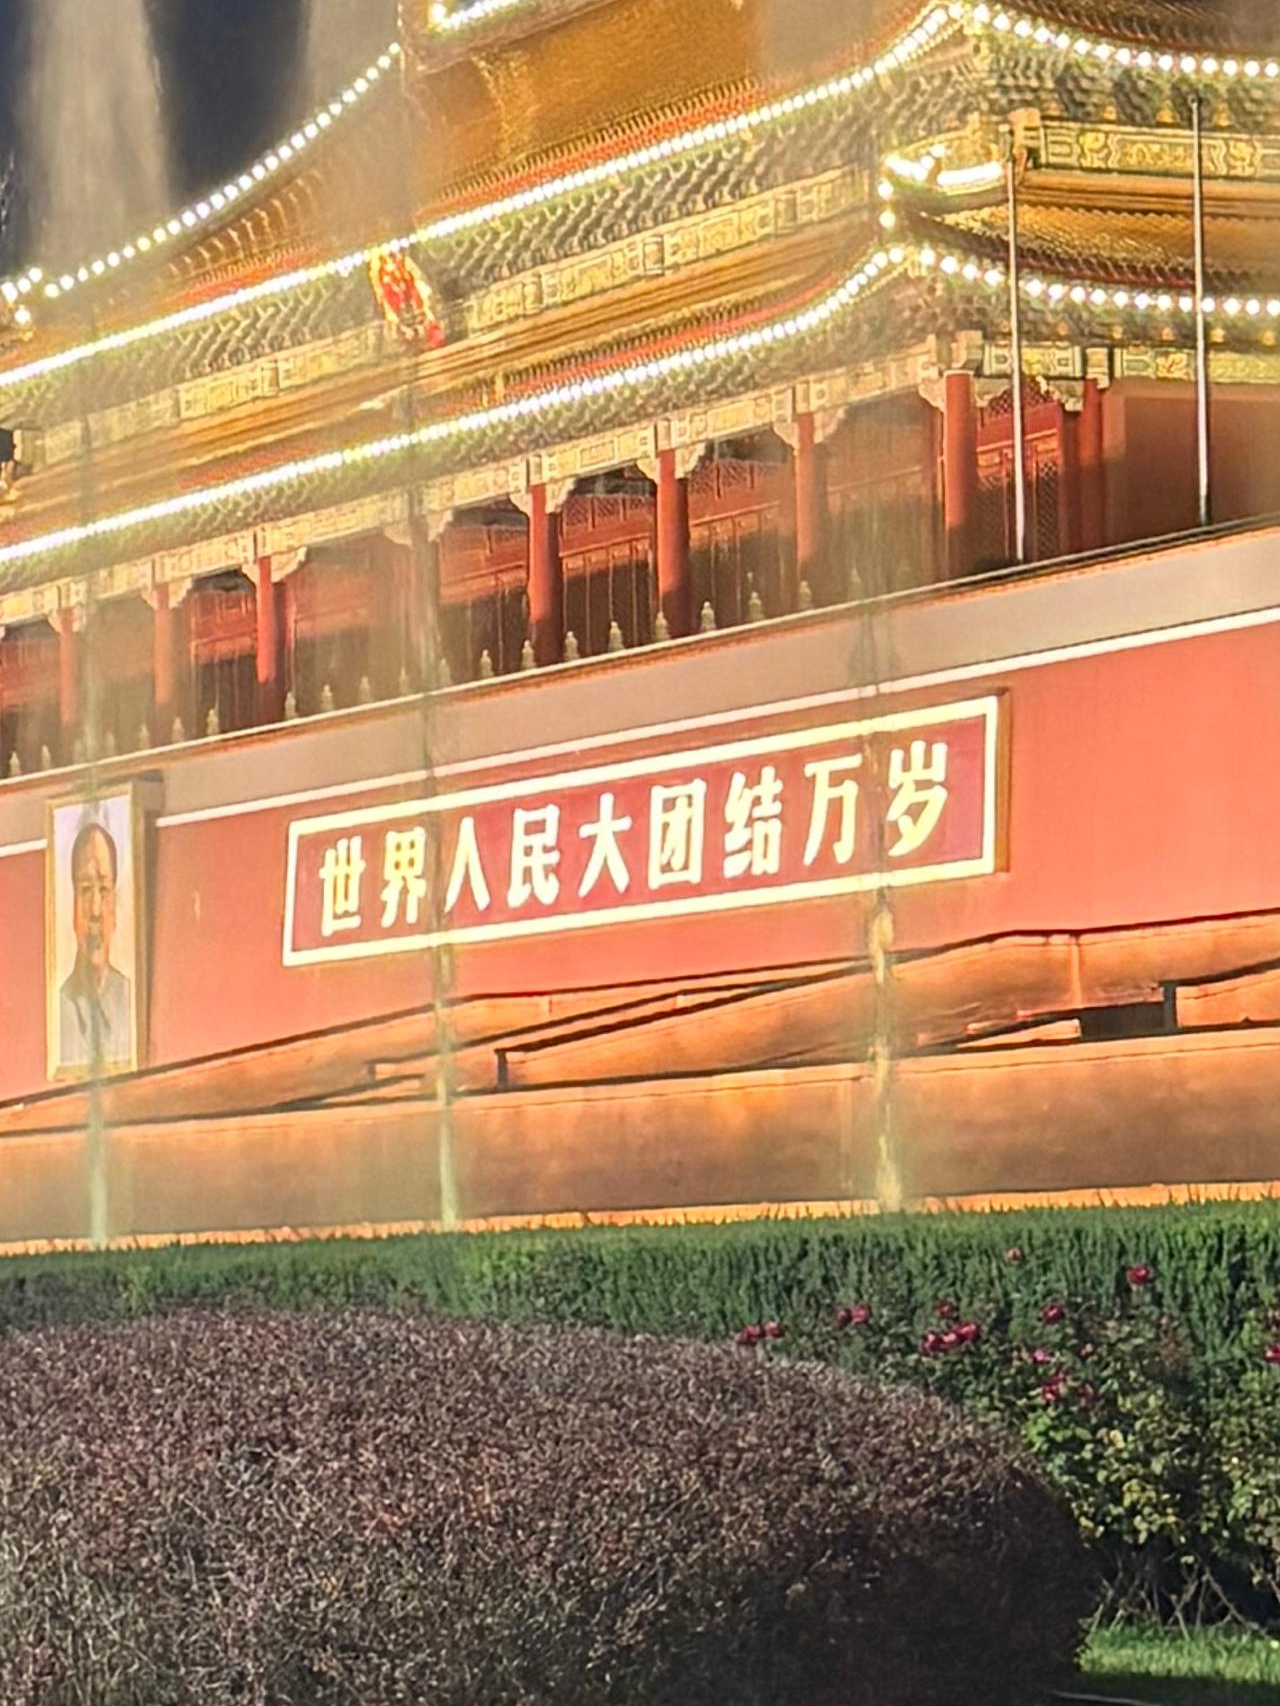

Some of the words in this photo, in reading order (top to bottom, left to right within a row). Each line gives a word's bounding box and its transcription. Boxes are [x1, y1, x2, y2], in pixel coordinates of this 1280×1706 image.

[318, 740, 948, 937] 世界人民大团结万岁
